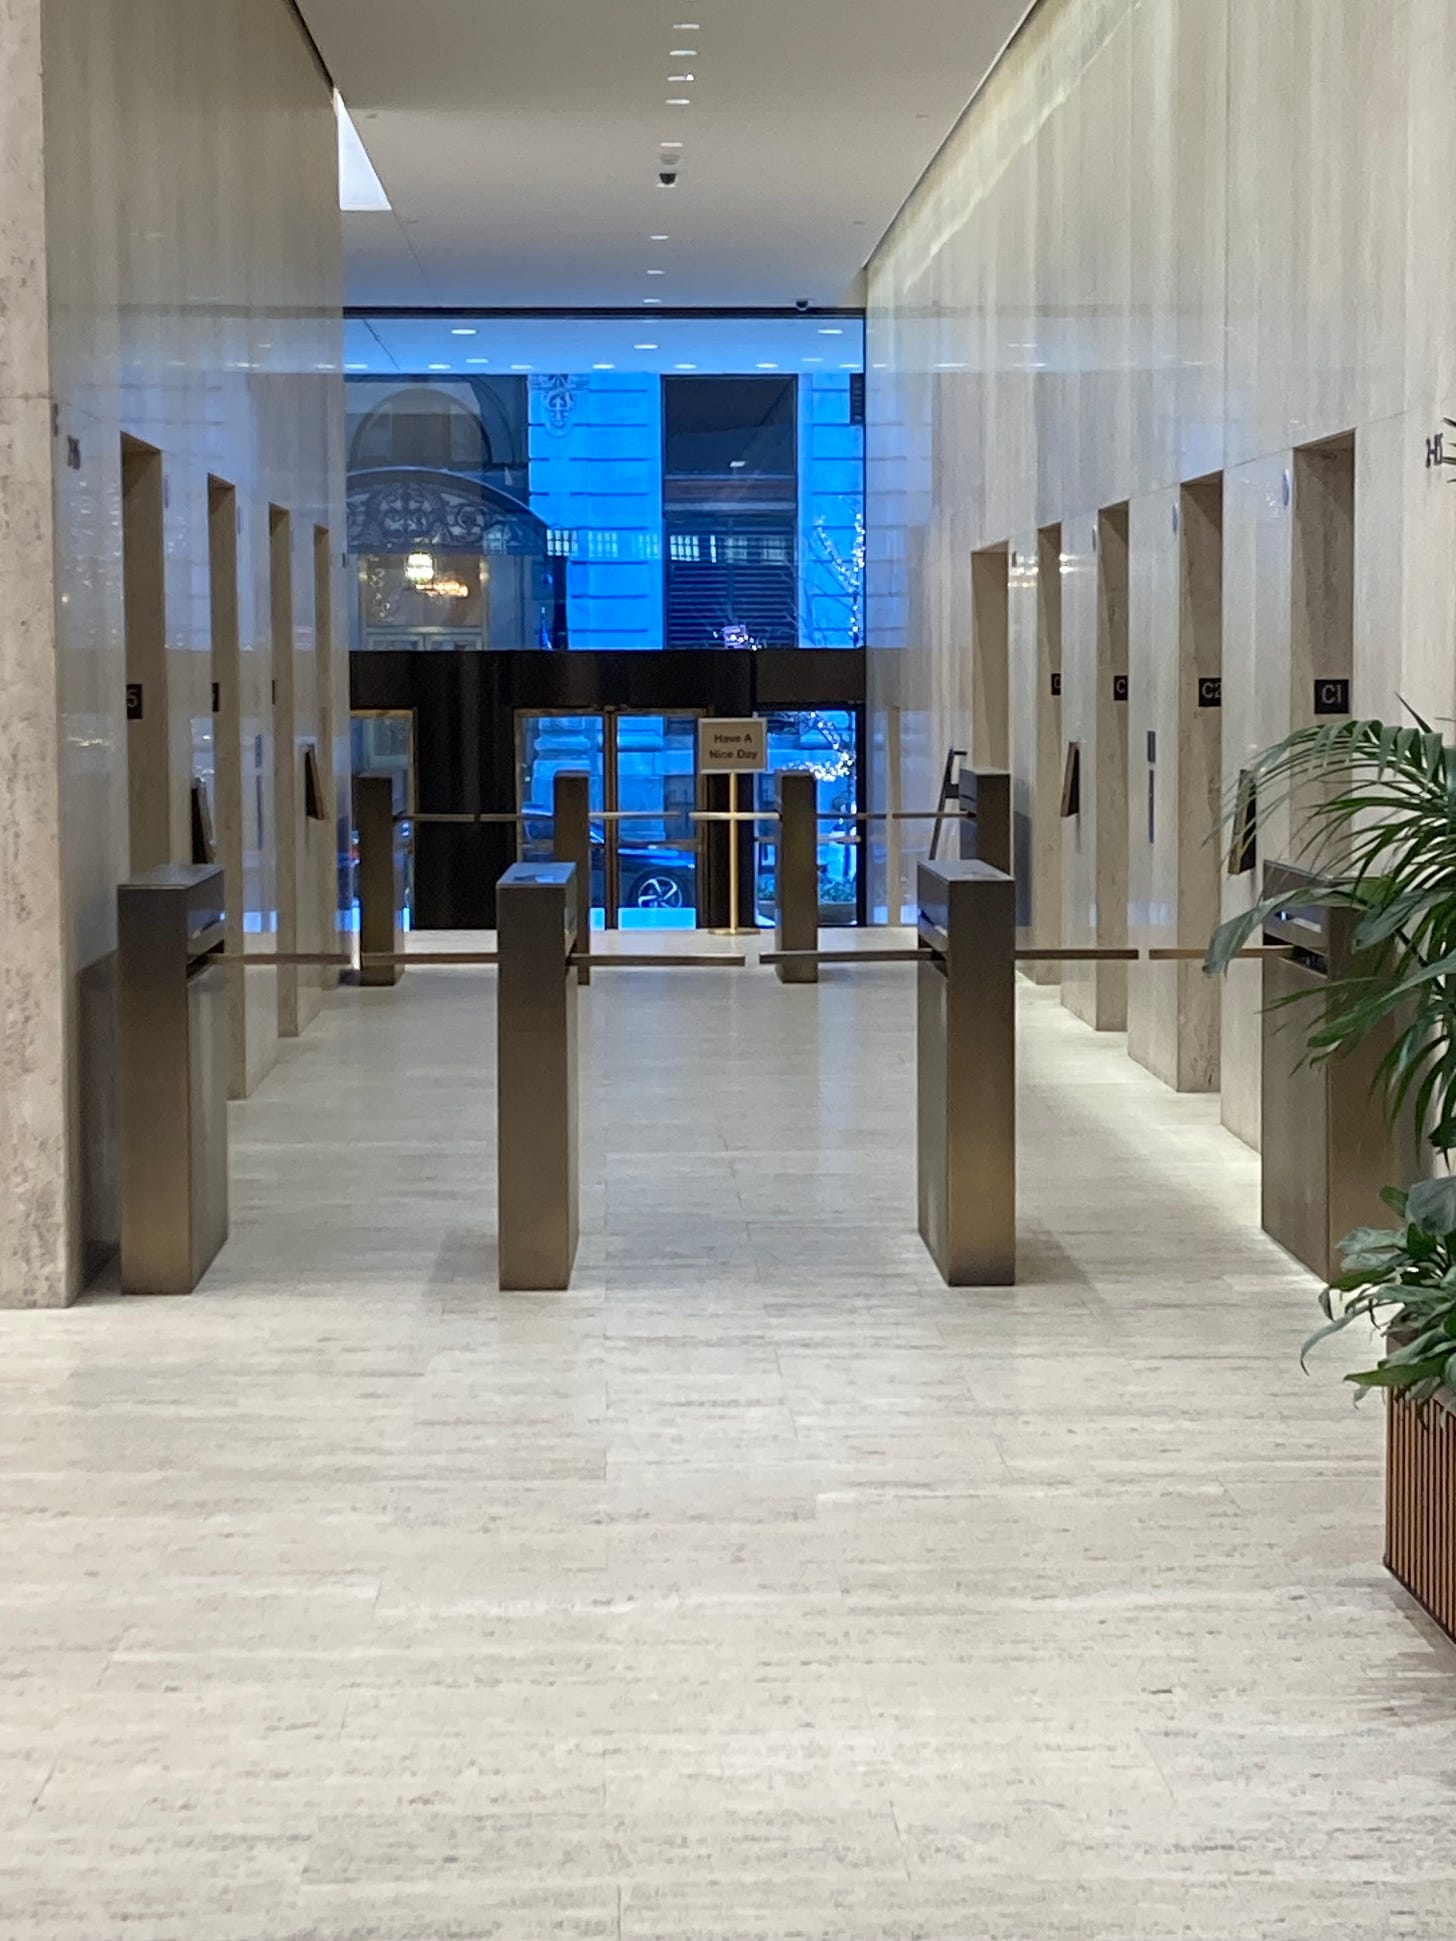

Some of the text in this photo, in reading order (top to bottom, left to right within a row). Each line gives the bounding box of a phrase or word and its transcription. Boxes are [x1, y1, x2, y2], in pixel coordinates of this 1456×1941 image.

[714, 733, 753, 743] Have A
[709, 749, 758, 760] Nice Day
